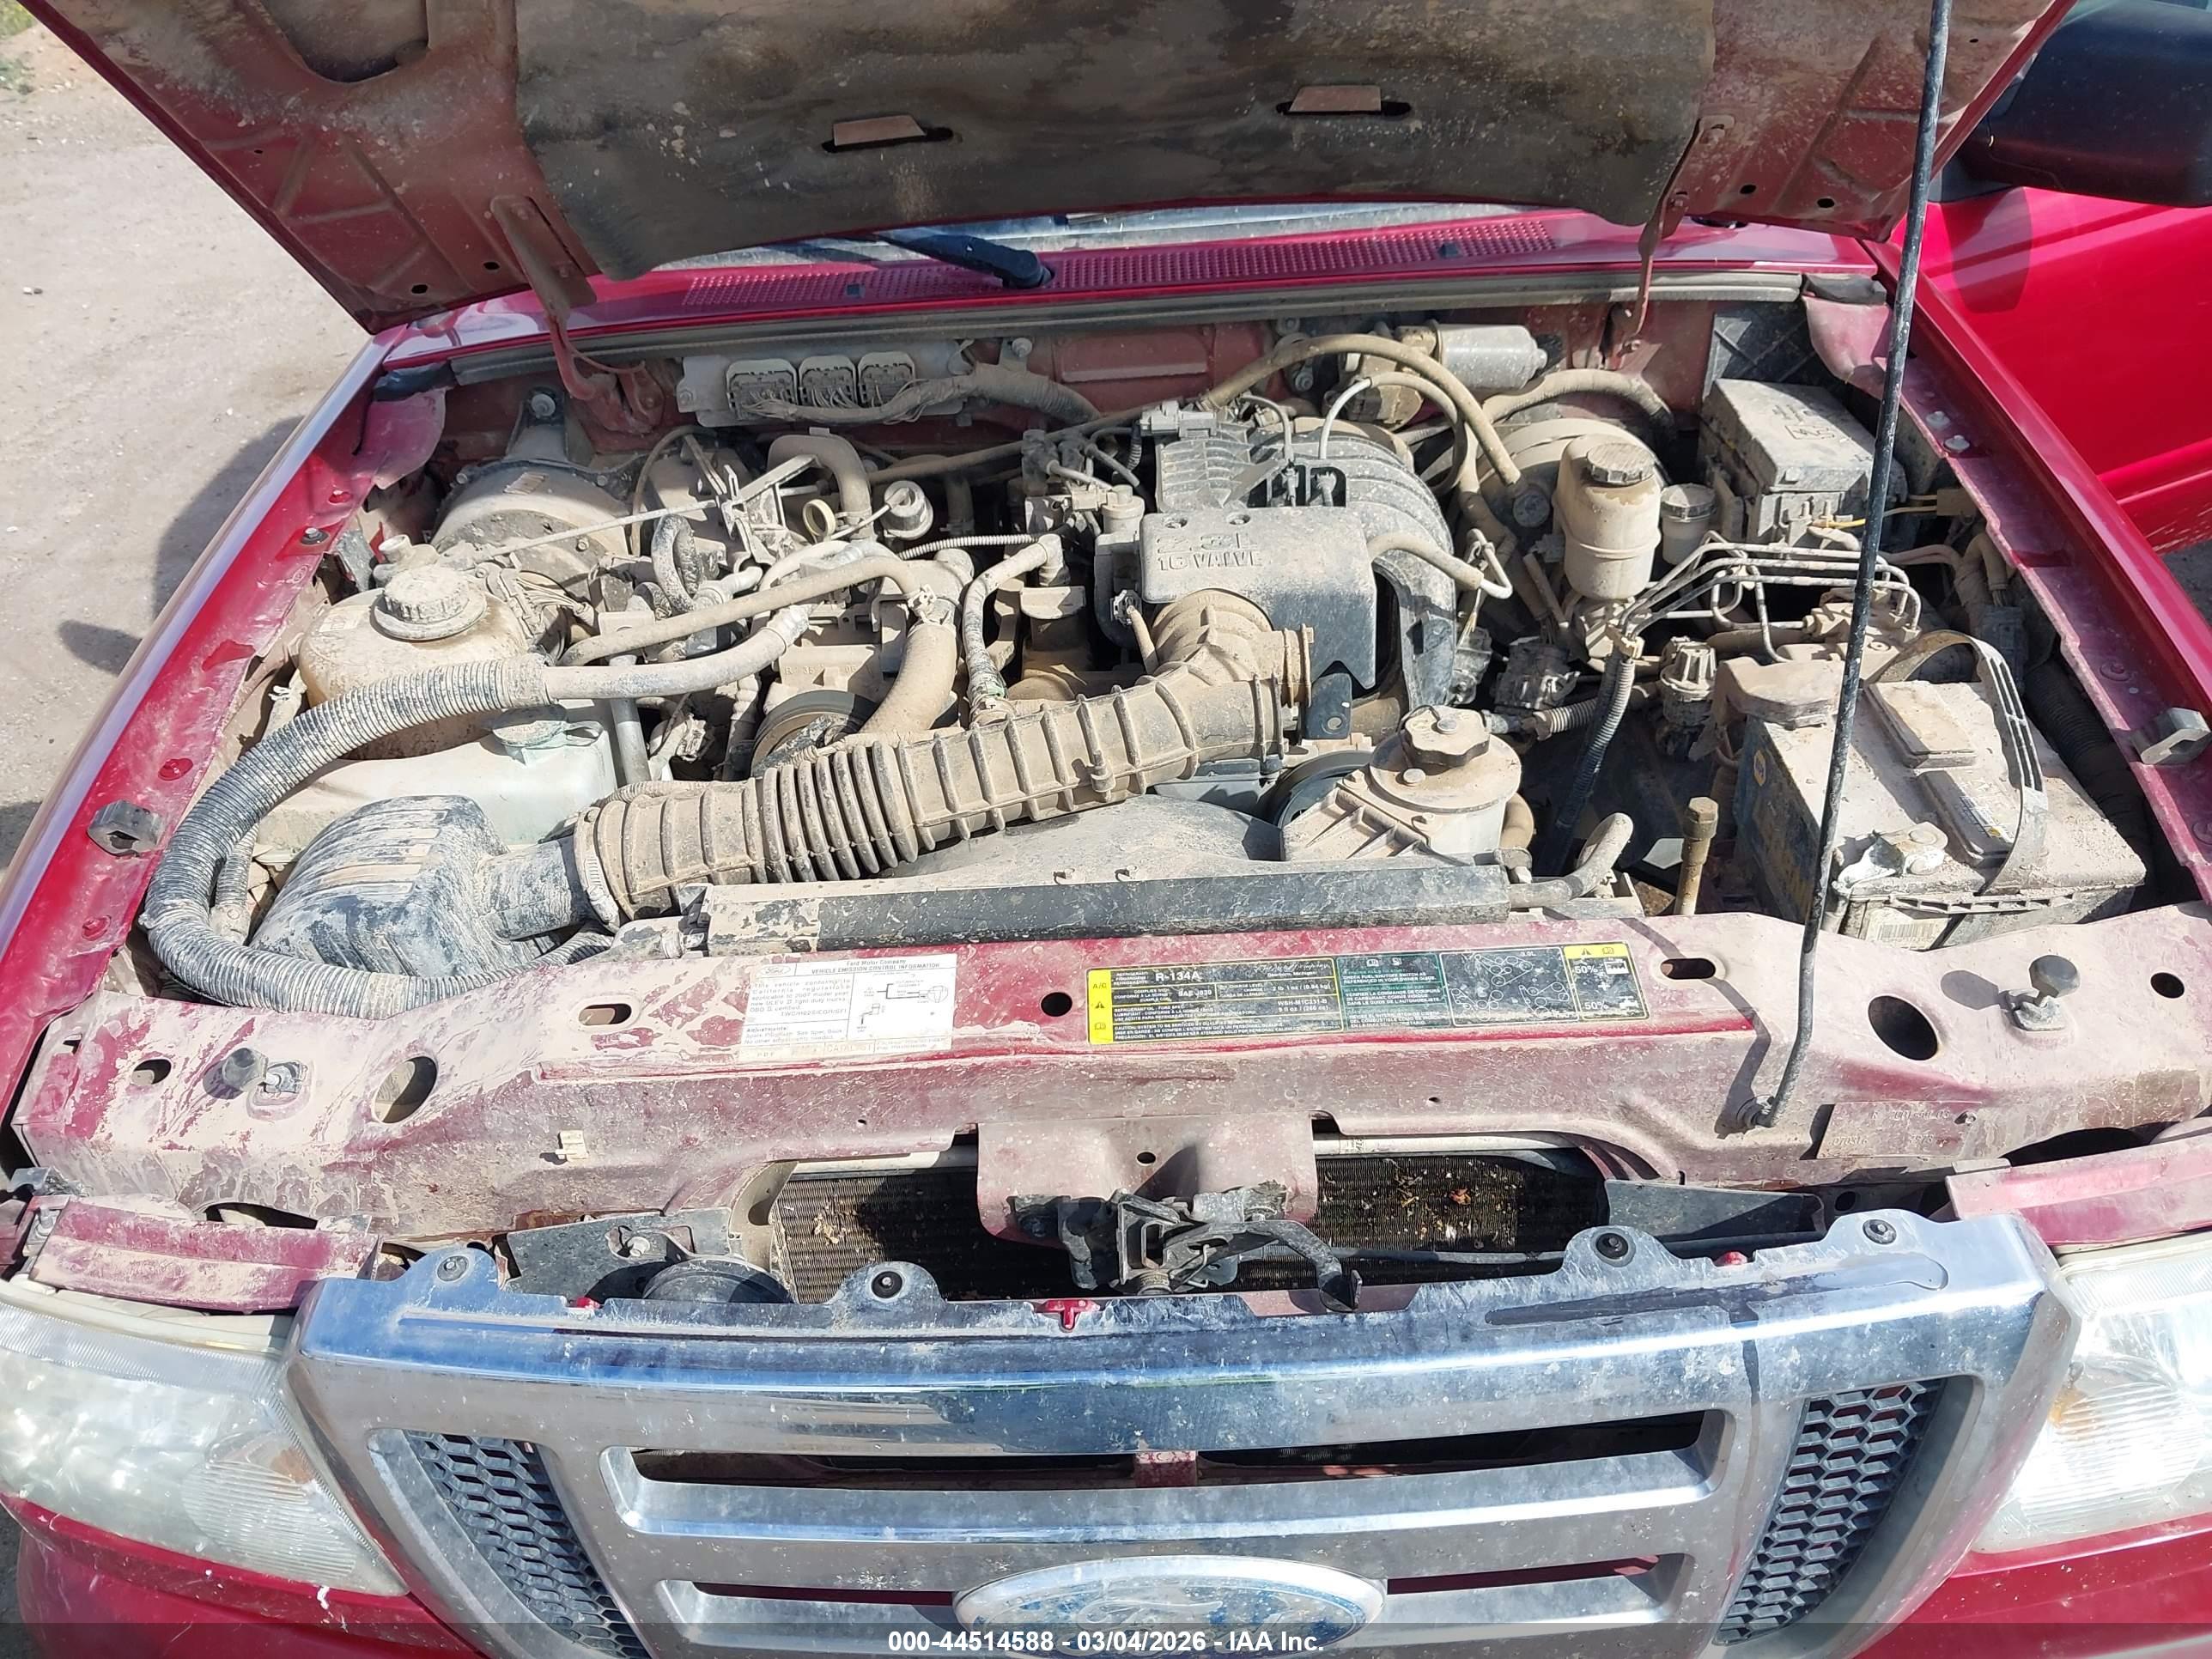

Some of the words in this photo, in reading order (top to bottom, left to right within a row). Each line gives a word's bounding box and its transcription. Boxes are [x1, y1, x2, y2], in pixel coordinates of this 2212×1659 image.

[1158, 557, 1188, 571] 16
[1193, 550, 1263, 568] VALVE
[1575, 965, 1598, 975] 50%
[1156, 971, 1200, 981] R-134A
[1584, 1001, 1608, 1011] 50%
